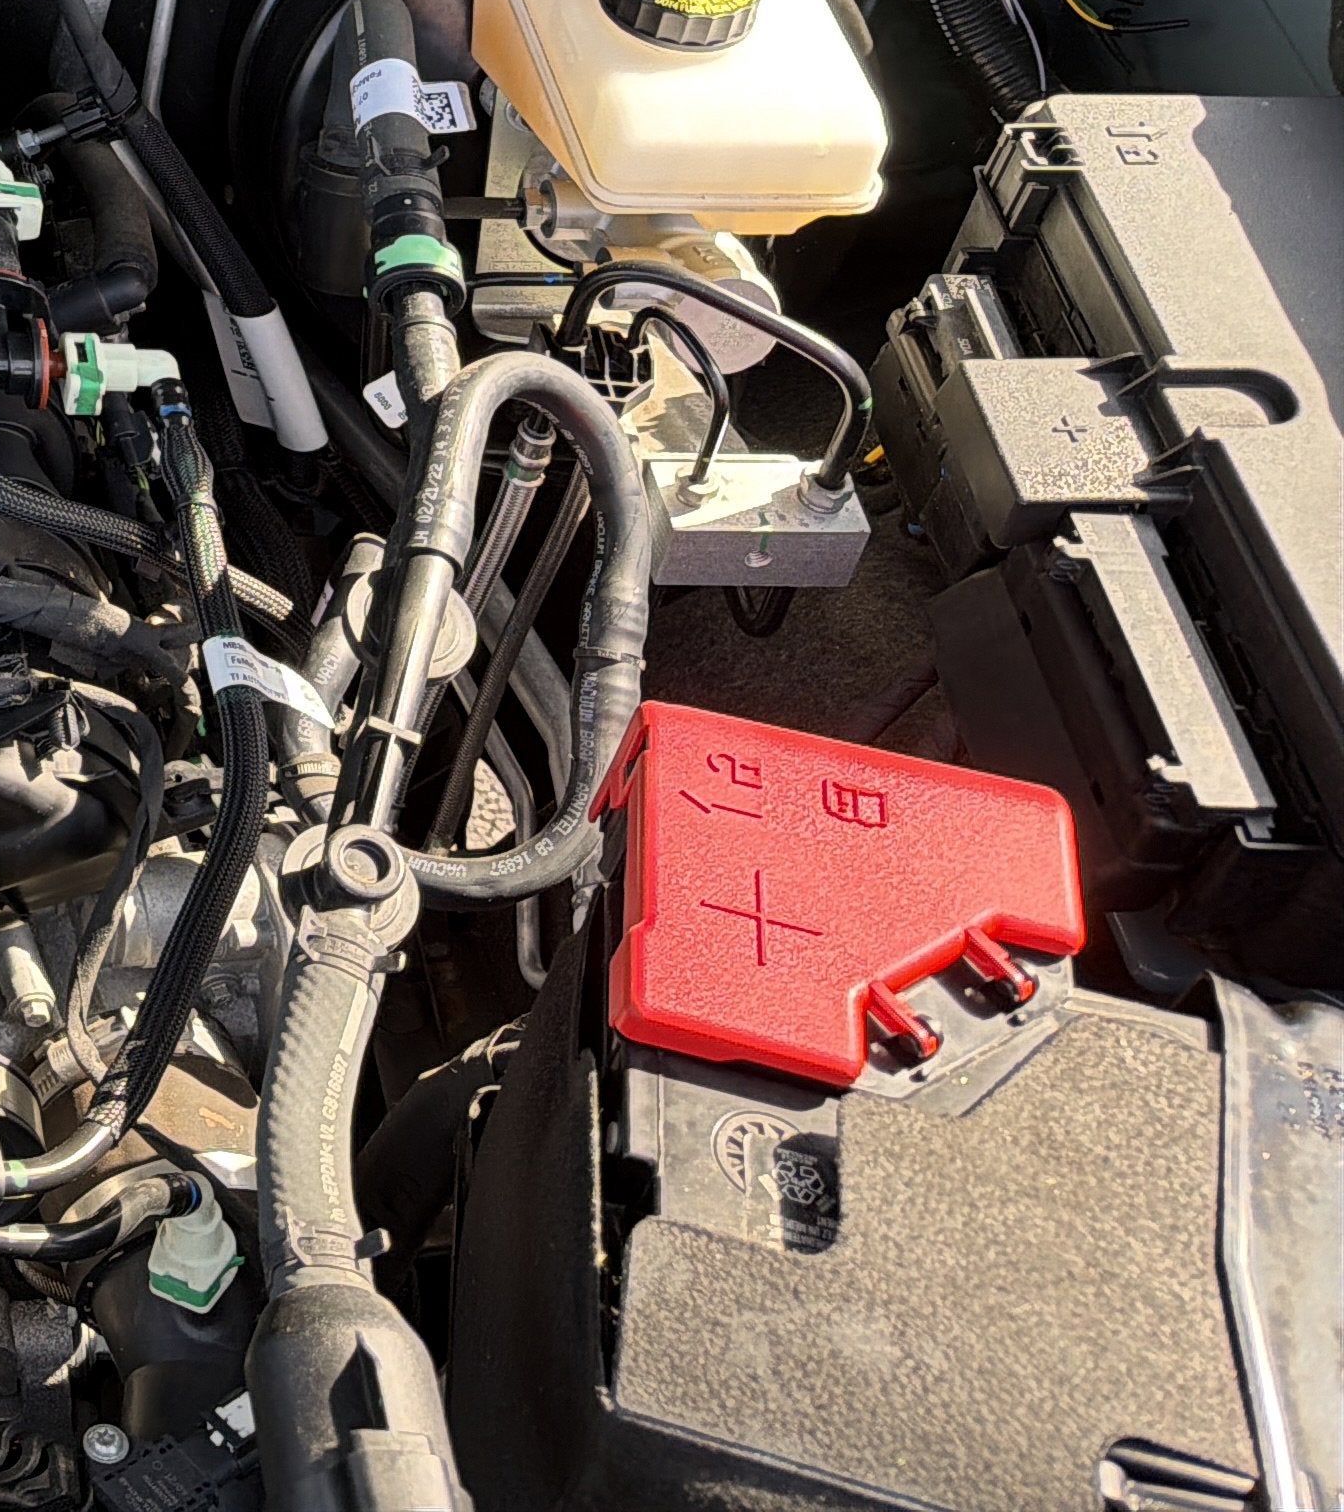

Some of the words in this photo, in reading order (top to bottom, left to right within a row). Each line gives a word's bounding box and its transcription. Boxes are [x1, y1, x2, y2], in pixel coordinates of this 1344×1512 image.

[415, 462, 445, 524] 02/21/22
[578, 672, 599, 723] VACUUM
[552, 781, 591, 837] ARNITEL
[322, 1053, 349, 1121] GB16897
